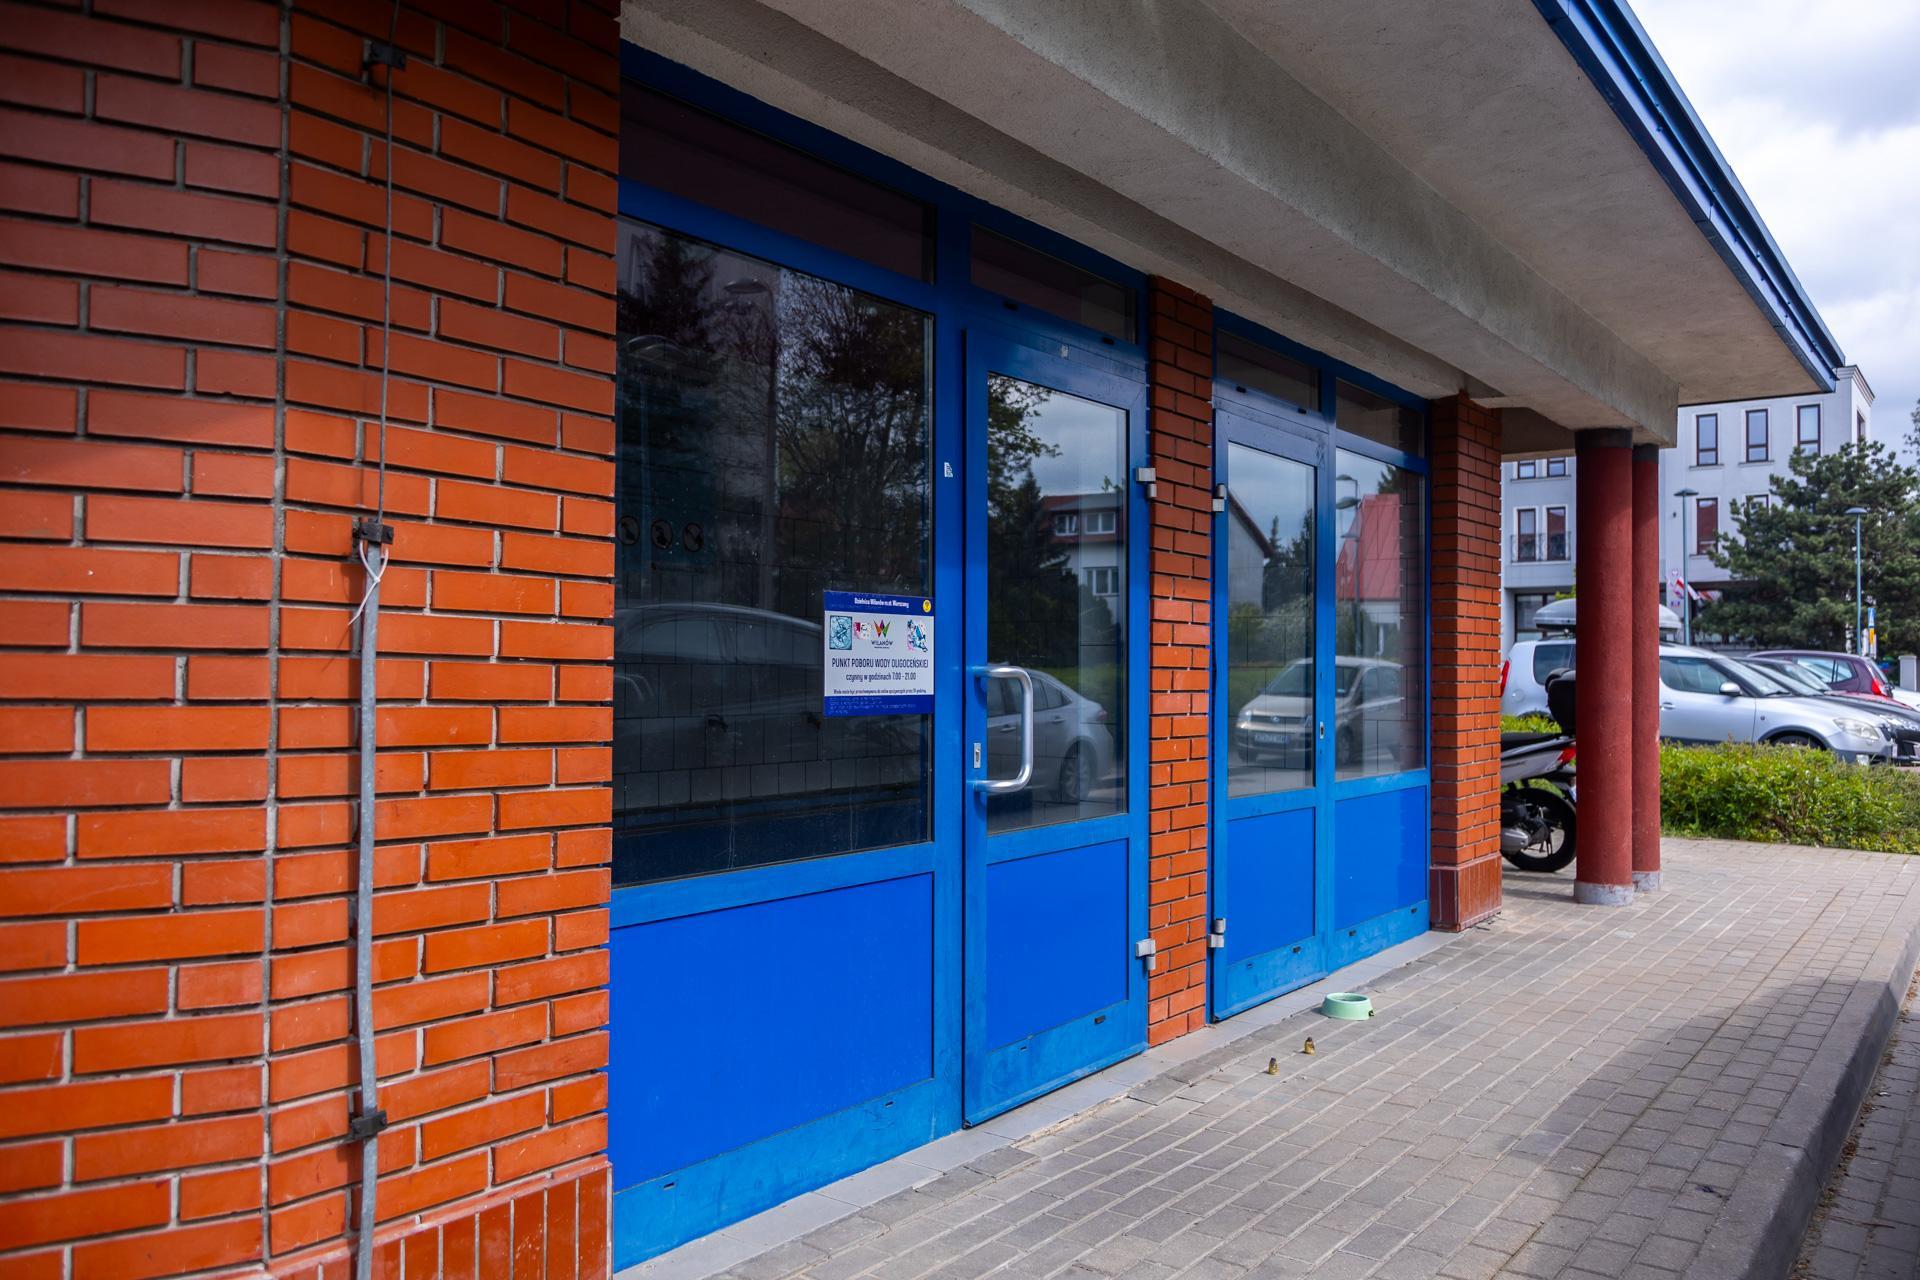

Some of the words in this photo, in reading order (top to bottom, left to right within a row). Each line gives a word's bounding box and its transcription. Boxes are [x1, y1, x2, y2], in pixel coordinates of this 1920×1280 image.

[832, 657, 850, 668] PUNKT
[852, 658, 873, 668] POBORU
[875, 658, 890, 668] WODY
[892, 657, 928, 668] OLIGOCEŃSKIEJ
[846, 674, 863, 682] czynny
[868, 672, 891, 682] godzinach
